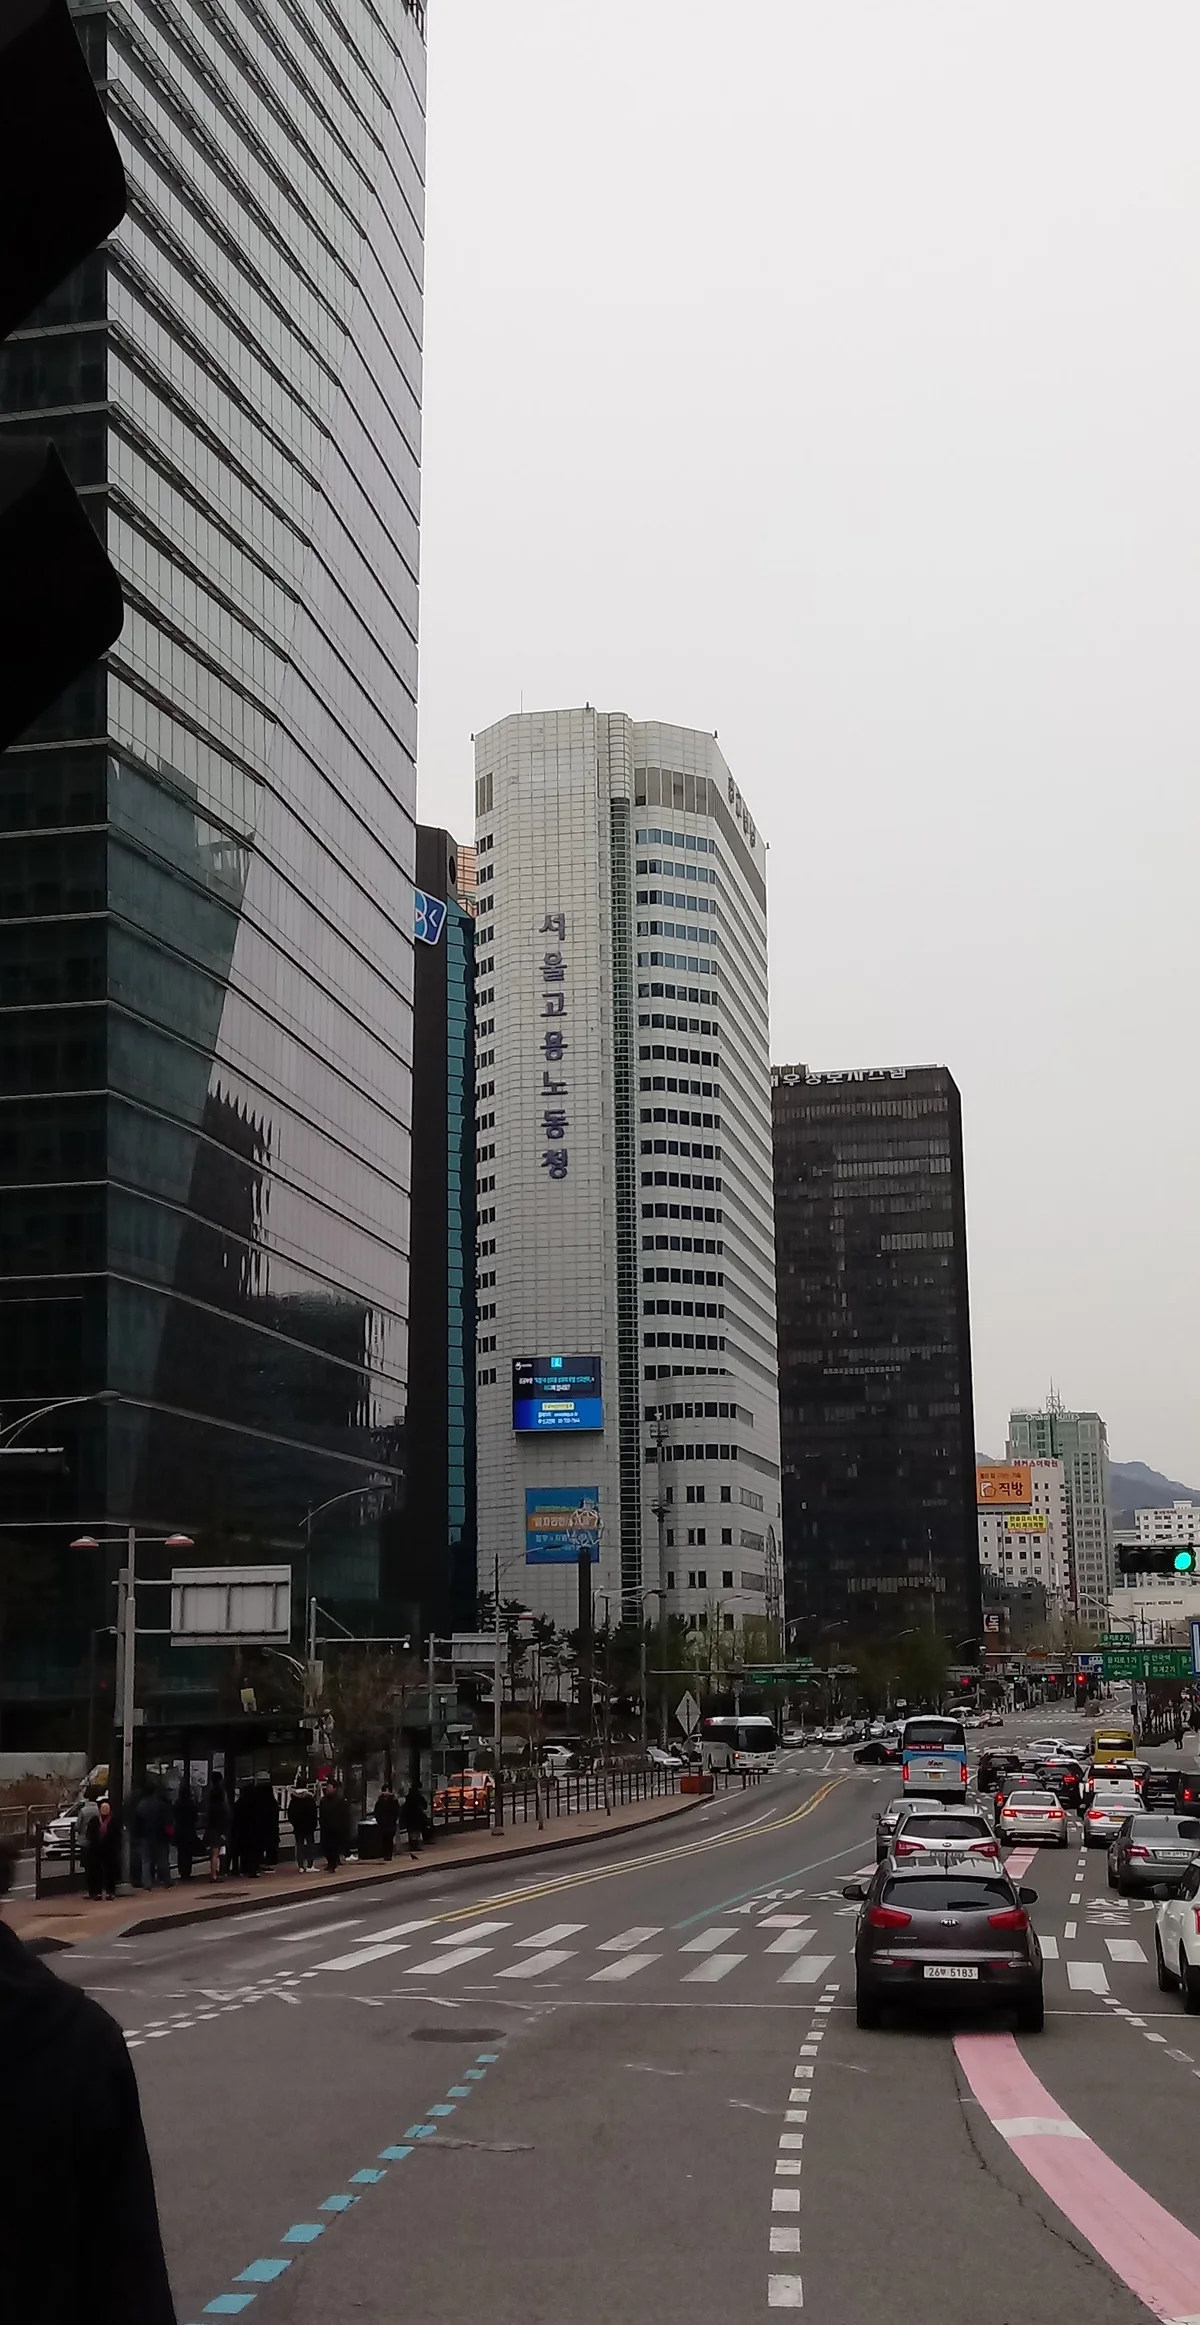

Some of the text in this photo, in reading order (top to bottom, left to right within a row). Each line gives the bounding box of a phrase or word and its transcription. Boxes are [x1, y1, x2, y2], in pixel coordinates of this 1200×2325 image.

[539, 912, 569, 1179] 서울고용노동청
[998, 1481, 1023, 1497] 직방
[1103, 1634, 1130, 1642] 을지로2가
[1107, 1656, 1137, 1664] 을지로1가
[950, 1968, 974, 1978] 5183
